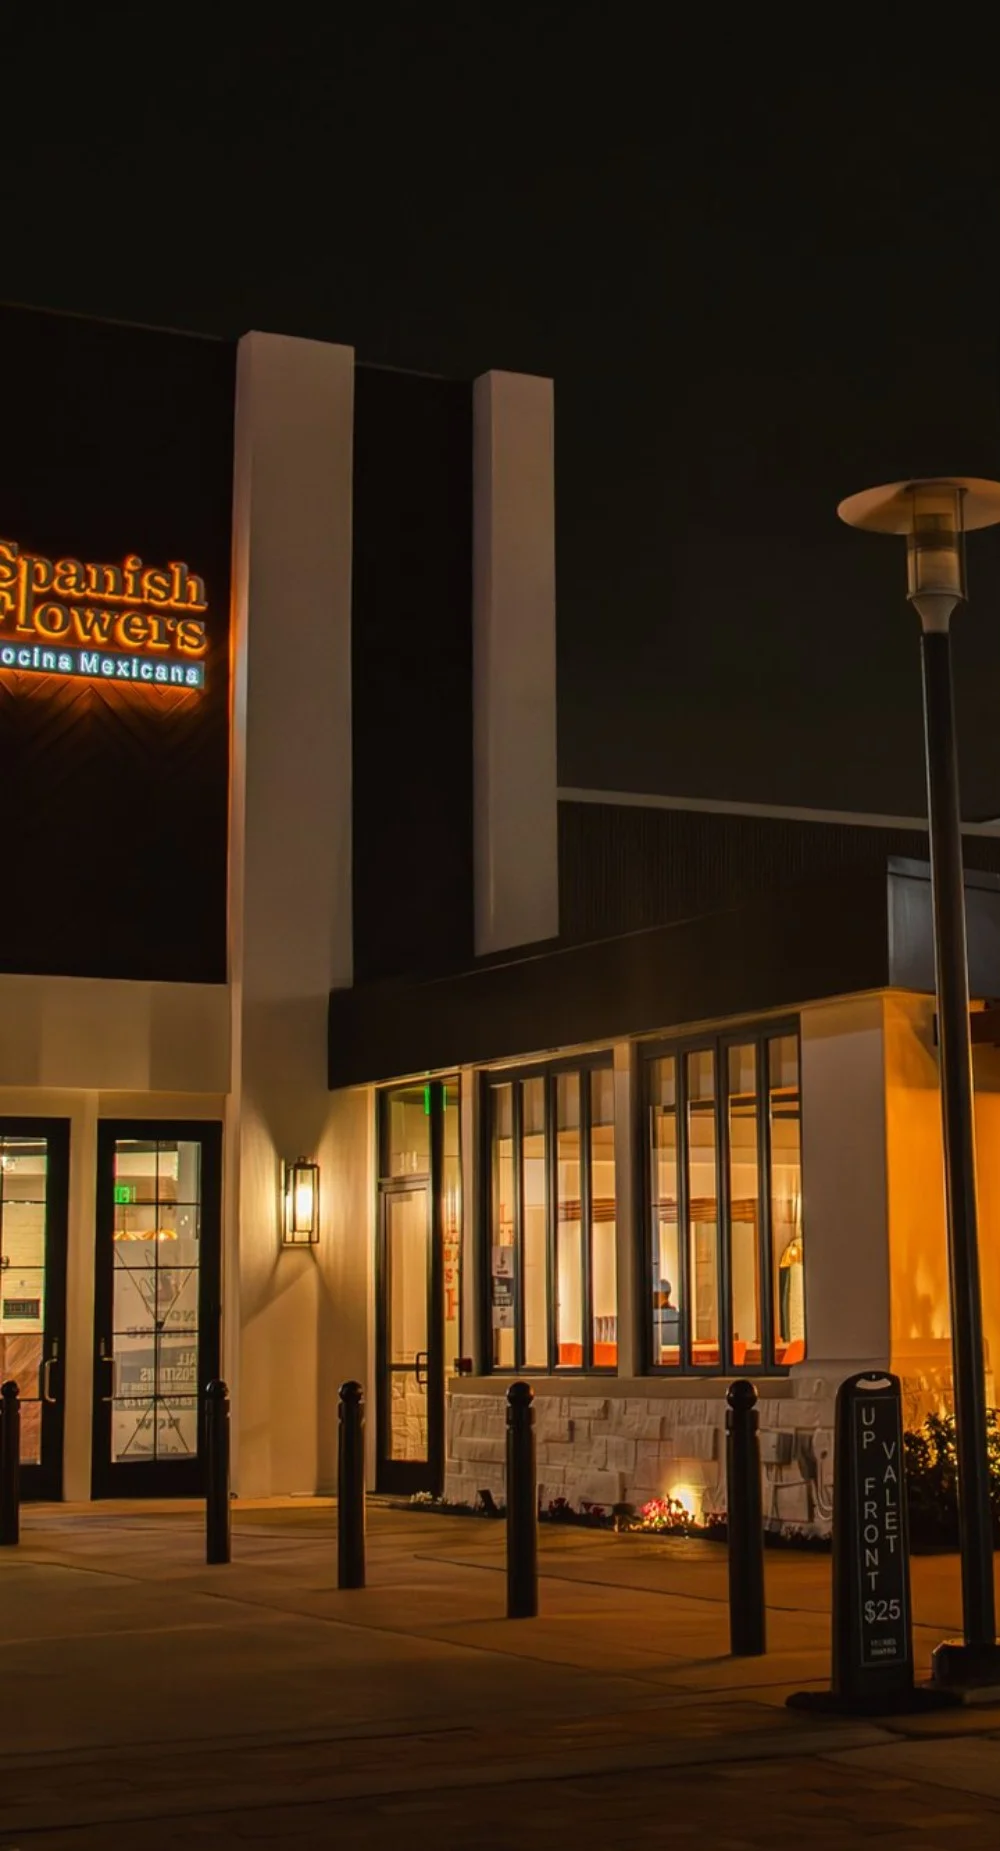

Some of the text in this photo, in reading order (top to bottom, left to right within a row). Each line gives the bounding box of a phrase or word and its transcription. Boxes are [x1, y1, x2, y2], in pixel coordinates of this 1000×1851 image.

[0, 539, 208, 614] Spanish
[80, 652, 199, 685] Mexicana
[861, 1407, 879, 1591] UP FRONT
[882, 1440, 899, 1554] VALET
[864, 1598, 901, 1625] $25
